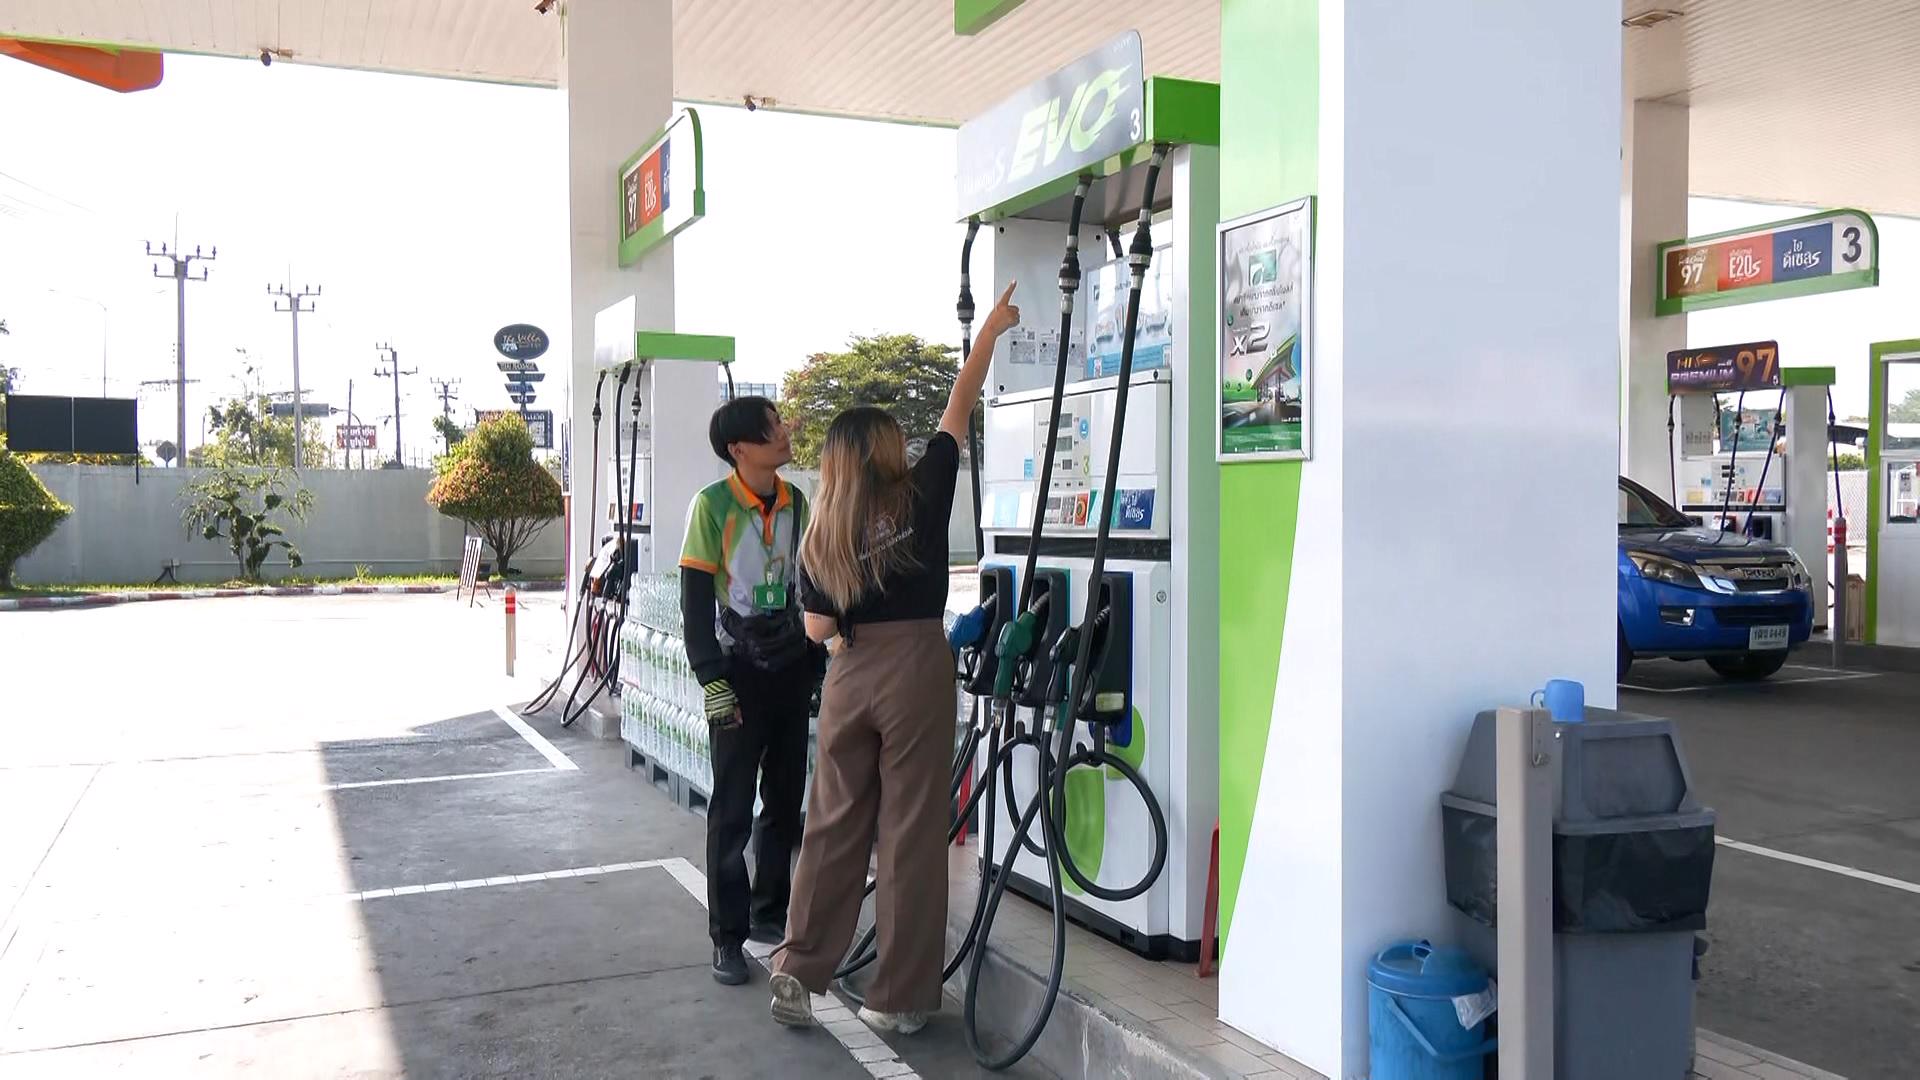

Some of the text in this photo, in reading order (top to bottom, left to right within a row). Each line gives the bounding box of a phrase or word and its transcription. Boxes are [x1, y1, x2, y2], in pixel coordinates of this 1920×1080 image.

[1008, 63, 1132, 183] EVO
[1130, 108, 1141, 140] 3
[628, 193, 637, 223] 97
[1842, 227, 1861, 264] 3
[1681, 262, 1704, 285] 97
[1736, 347, 1777, 384] 97
[1083, 455, 1090, 476] 3
